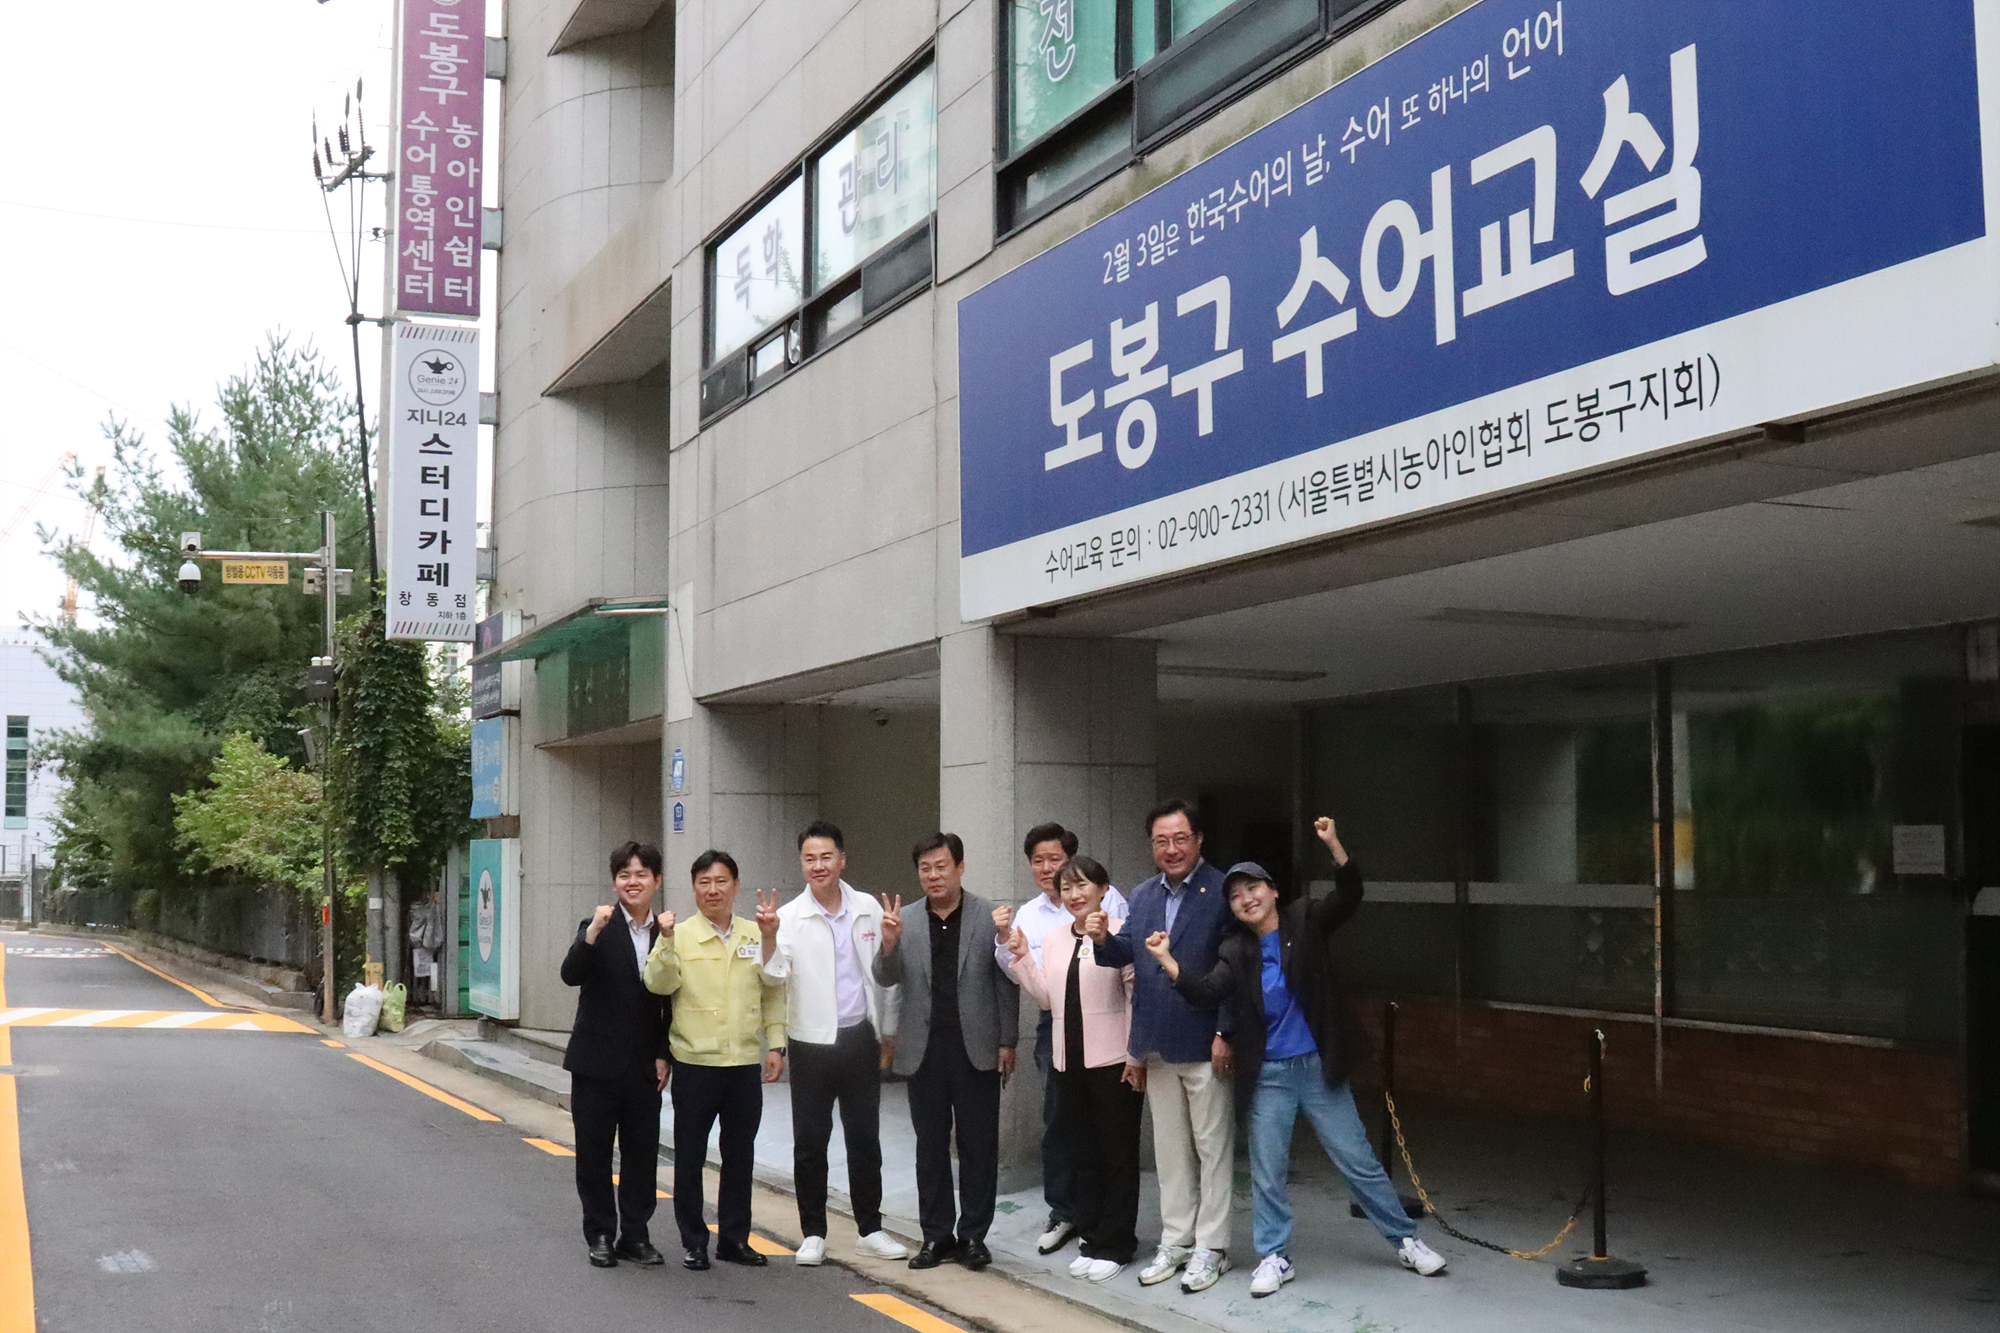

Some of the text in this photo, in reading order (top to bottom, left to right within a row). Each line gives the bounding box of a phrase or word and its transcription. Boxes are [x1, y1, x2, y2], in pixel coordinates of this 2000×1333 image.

[419, 12, 469, 105] 도봉구
[1103, 1, 1563, 284] 2월 3일은 한국수어의 날, 수어 또 하나의 언어
[402, 111, 440, 304] 수어통역센터
[443, 116, 480, 307] 농아인쉼터
[1043, 42, 1708, 472] 도봉구 수어교실
[407, 408, 468, 427] 지니24
[416, 374, 447, 385] Genie
[417, 433, 453, 588] 스터디카페
[1045, 536, 1103, 584] 수어교육
[1110, 525, 1141, 561] 문의
[1158, 489, 1271, 550] 02-900-2331
[1278, 408, 1532, 522] (서울특별시농아인협회
[1543, 353, 1721, 445] 도봉구지회)
[438, 611, 453, 620] 지하
